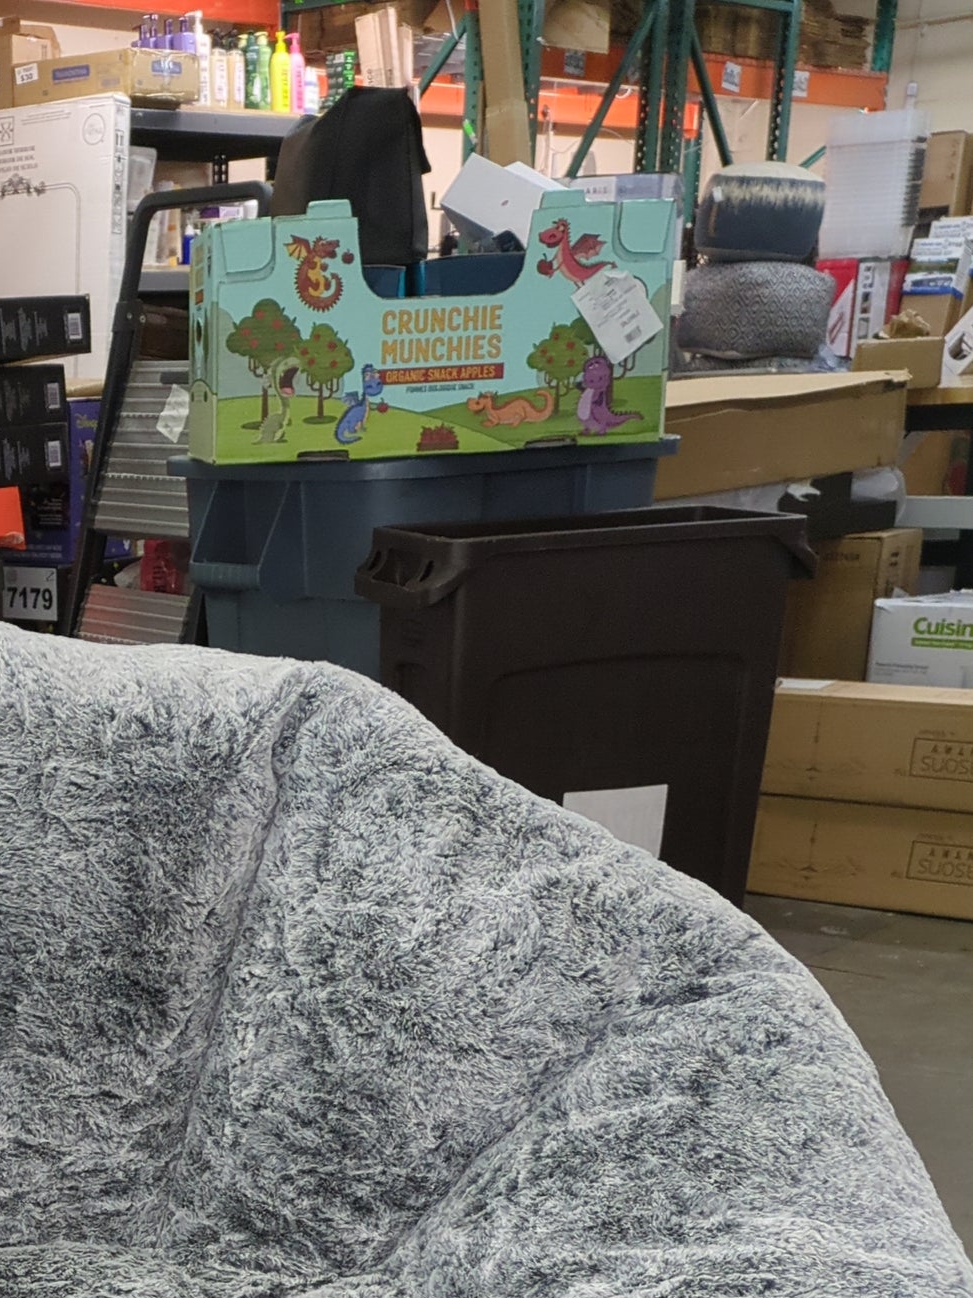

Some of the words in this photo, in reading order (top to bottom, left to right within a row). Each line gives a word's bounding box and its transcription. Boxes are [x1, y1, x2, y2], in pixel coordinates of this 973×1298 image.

[381, 304, 503, 335] CRUNCHIE
[381, 333, 503, 365] MUNCHIES
[386, 370, 426, 383] ORGANIC
[427, 368, 458, 381] SNACK
[460, 365, 496, 379] APPLES
[7, 586, 54, 610] 7179
